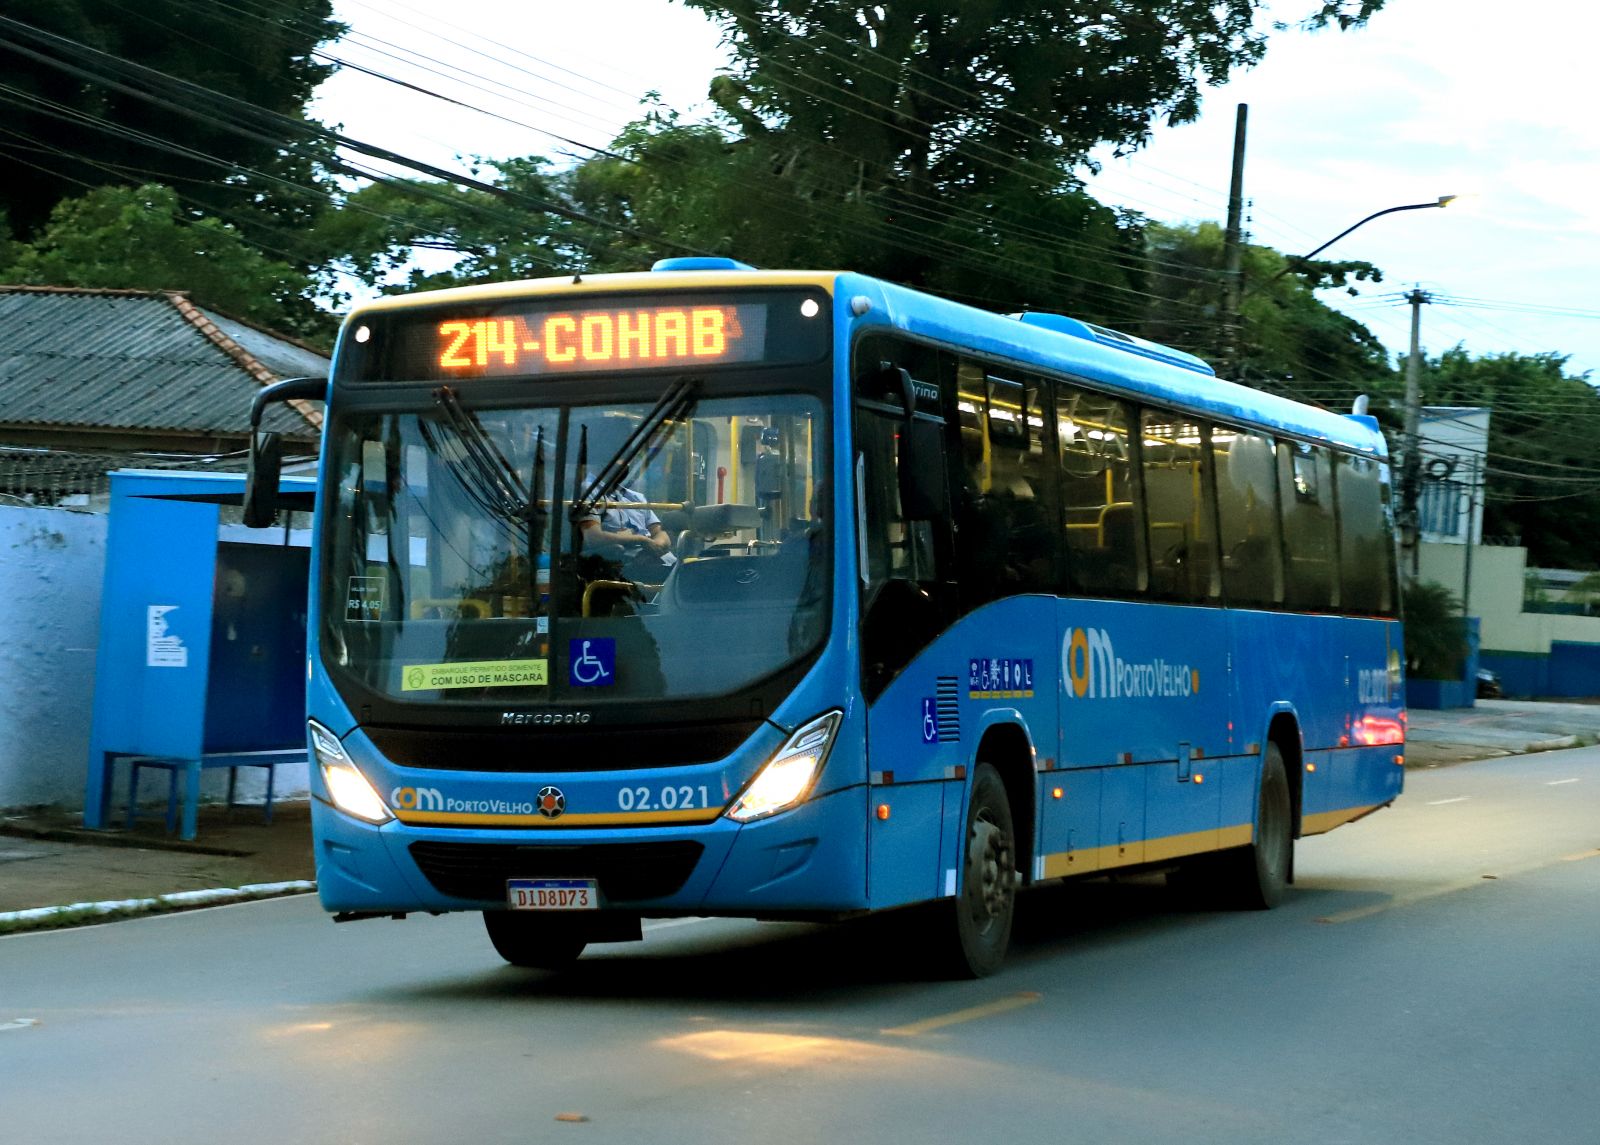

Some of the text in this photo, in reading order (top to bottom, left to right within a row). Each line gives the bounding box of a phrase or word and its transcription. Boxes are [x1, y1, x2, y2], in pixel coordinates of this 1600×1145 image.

[431, 671, 543, 686] COM USO DE MÁSCARA
[500, 711, 592, 726] Marcopolo
[617, 785, 708, 811] 02.021
